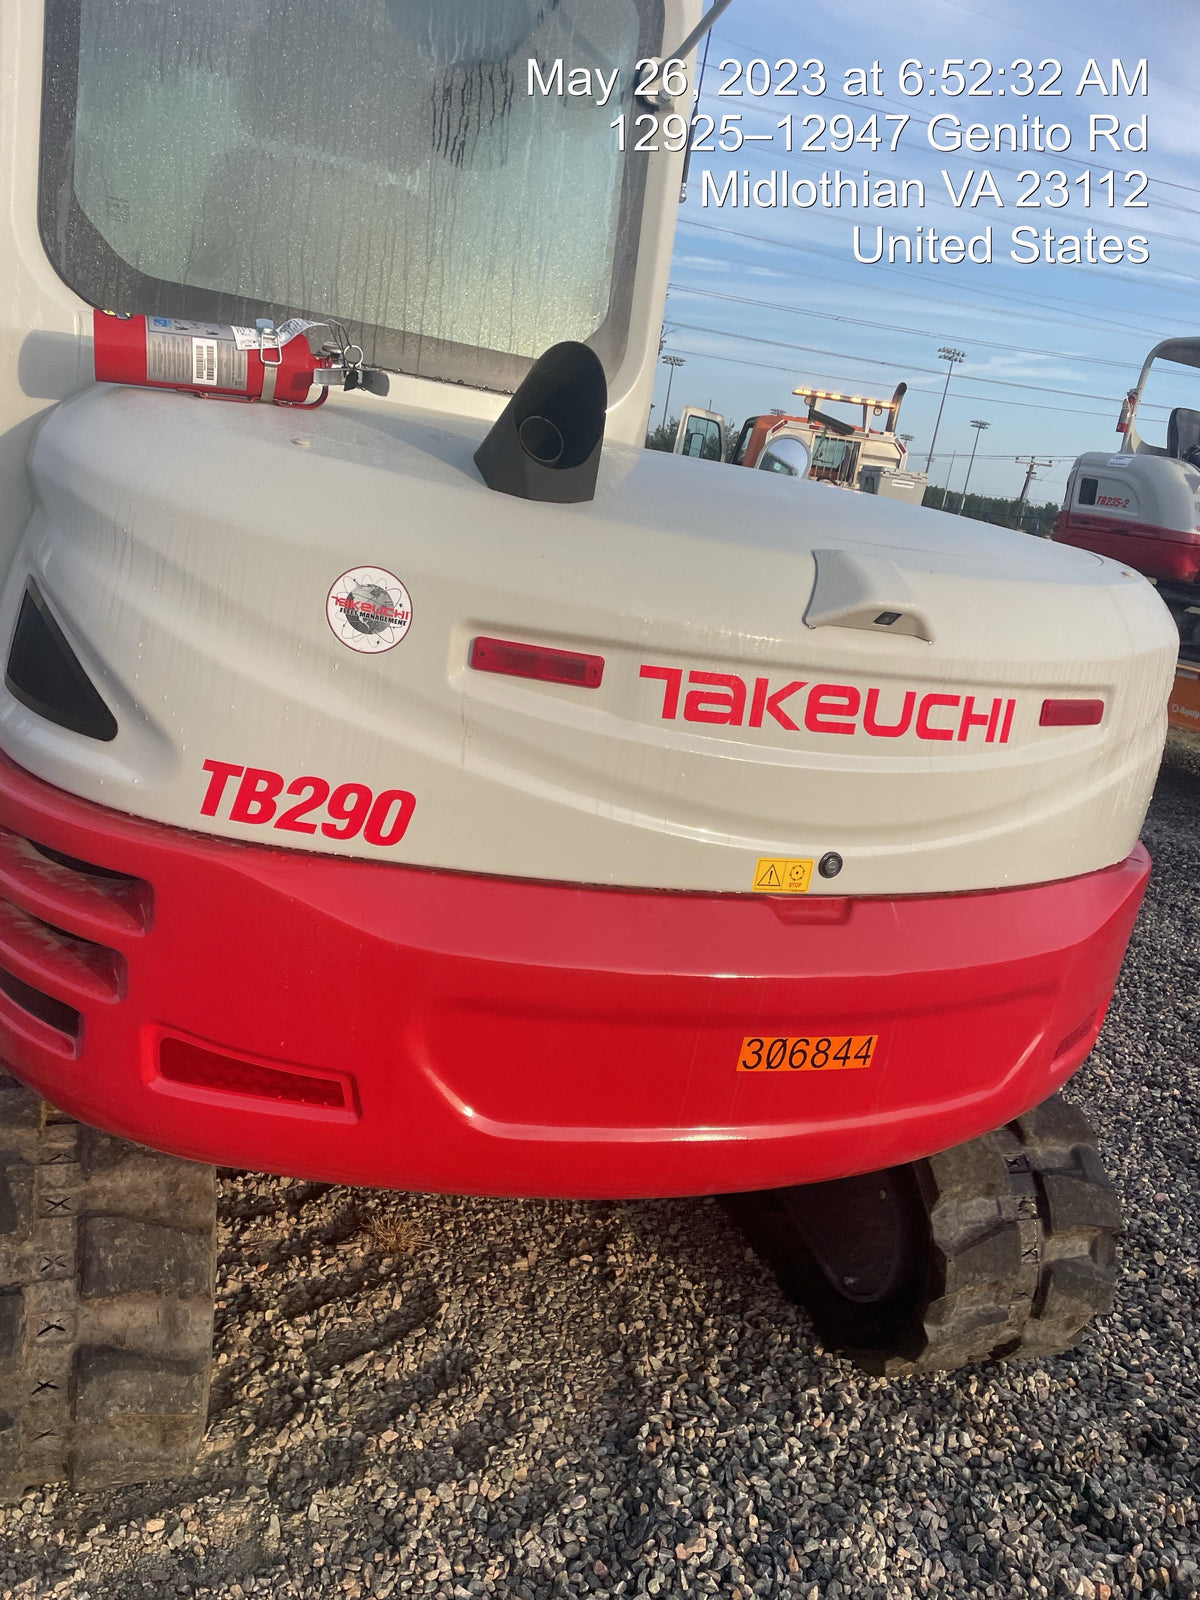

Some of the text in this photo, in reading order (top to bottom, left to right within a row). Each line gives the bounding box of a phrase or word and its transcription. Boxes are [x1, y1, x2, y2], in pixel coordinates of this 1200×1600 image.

[339, 607, 407, 626] FLEET MANAGEMENT
[200, 758, 417, 847] TB290
[742, 1036, 873, 1070] 306844
